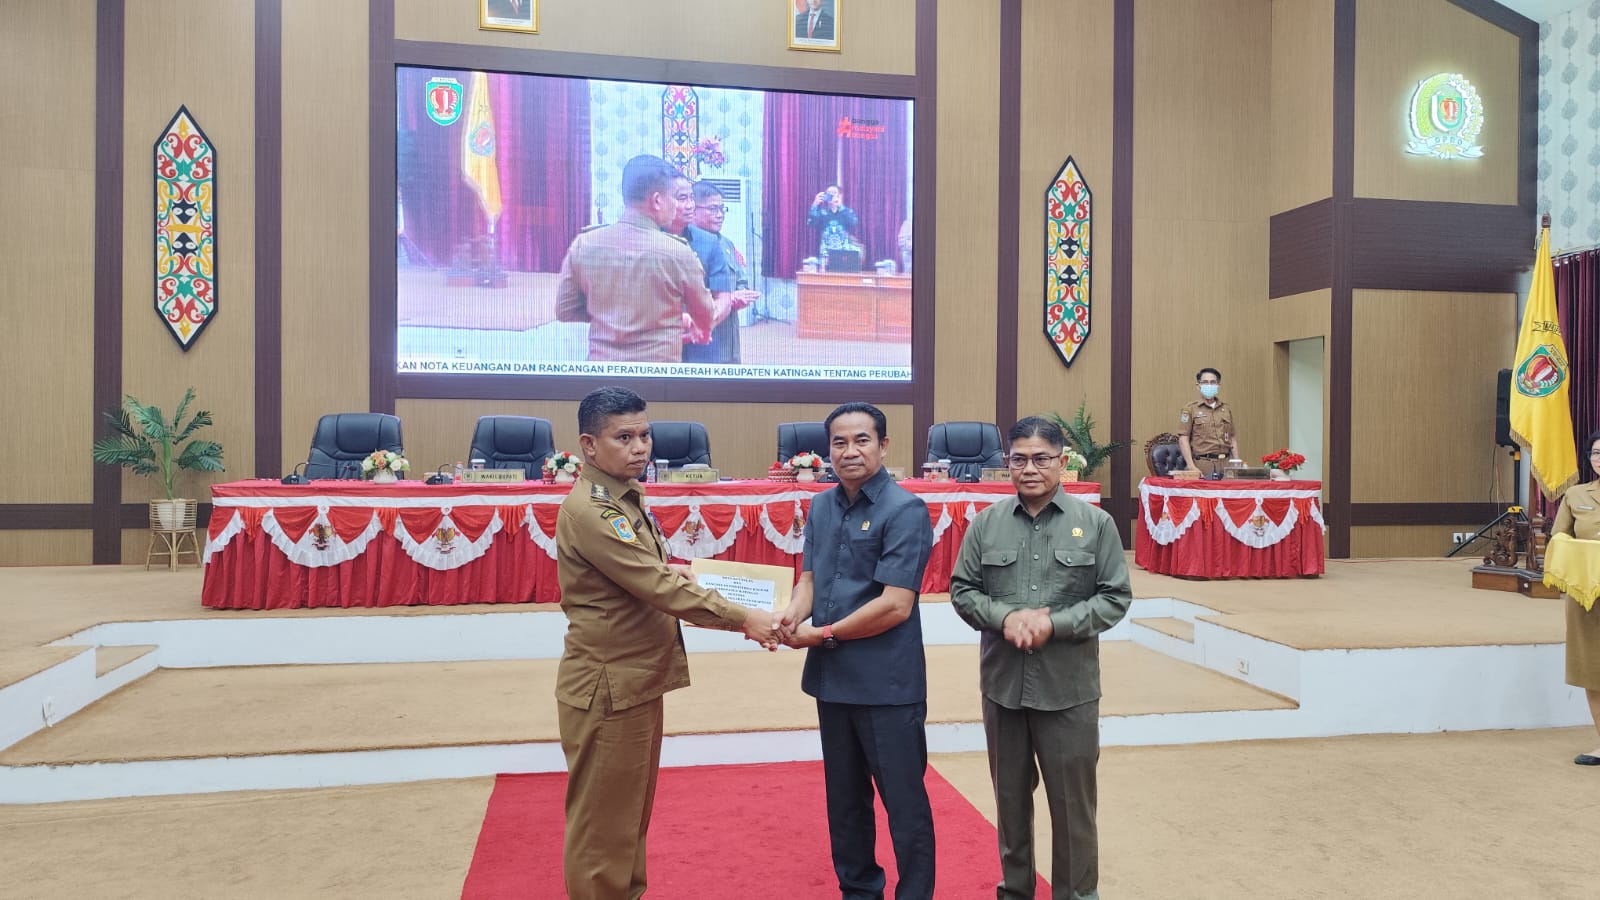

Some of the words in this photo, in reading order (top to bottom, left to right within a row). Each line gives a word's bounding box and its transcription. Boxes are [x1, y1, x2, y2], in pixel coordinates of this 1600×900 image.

[420, 361, 449, 371] NOTA
[451, 362, 511, 372] KEUANGAN
[514, 363, 536, 372] DAN
[539, 363, 604, 373] RANCANGAN
[607, 365, 667, 375] PERATURAN
[670, 366, 711, 376] DAERAH
[714, 367, 770, 377] KABUPATEN
[773, 368, 821, 377] KATINGAN
[824, 369, 867, 378] TENTANG
